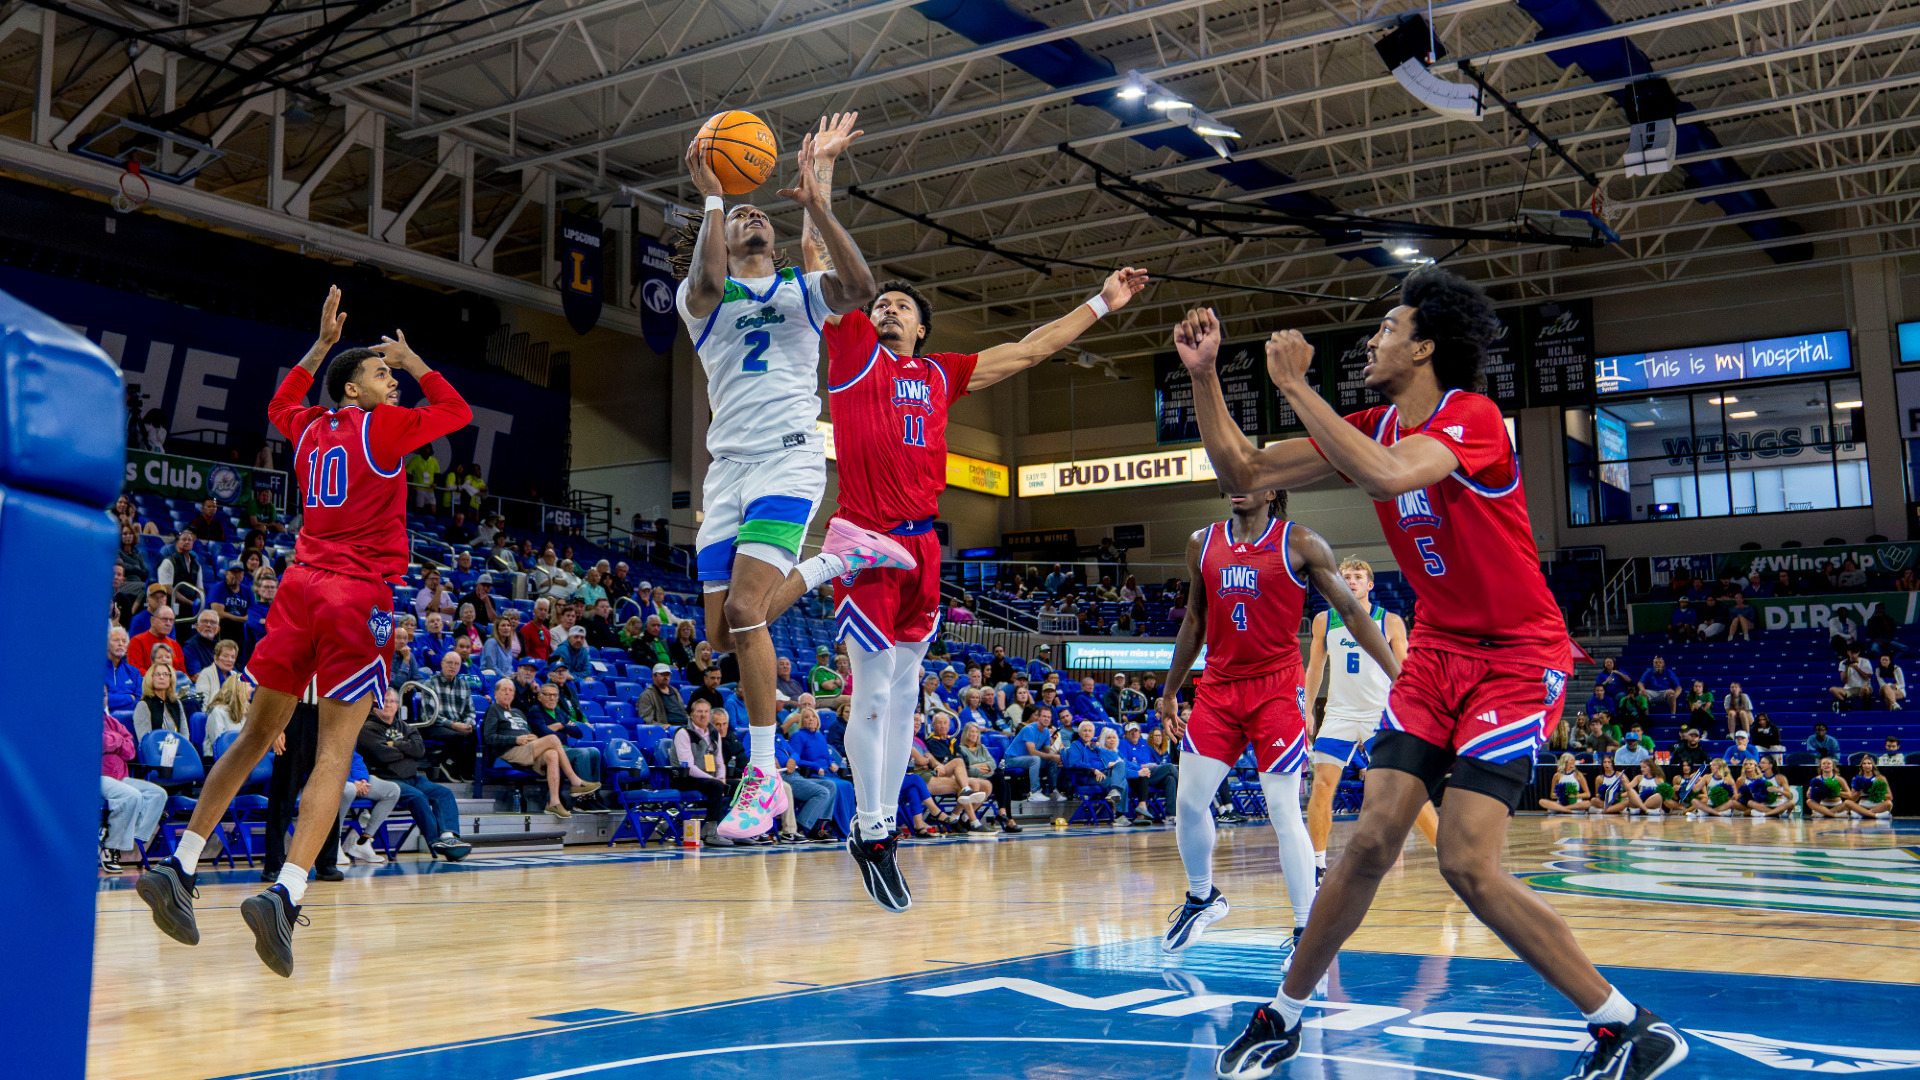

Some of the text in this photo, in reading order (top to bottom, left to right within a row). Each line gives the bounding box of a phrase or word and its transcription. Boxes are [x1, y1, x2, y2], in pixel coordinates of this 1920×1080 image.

[563, 227, 600, 248] LIPSCOMB
[571, 250, 593, 294] L
[735, 308, 786, 330] Eagles
[1538, 319, 1580, 338] FGCU
[741, 330, 771, 372] 2
[1535, 354, 1587, 367] APPEARANCES
[1547, 345, 1574, 357] NCAA
[1635, 336, 1833, 379] This is my hospital.
[1220, 357, 1255, 376] FGCU
[896, 380, 931, 405] UWG
[1225, 391, 1260, 401] URNAMENT
[1227, 382, 1249, 393] NCAA
[903, 414, 926, 446] 11
[1662, 427, 1804, 466] WINGS
[144, 460, 203, 490] Club
[306, 445, 349, 507] 10
[1059, 456, 1188, 487] BUD LIGHT
[1396, 487, 1432, 518] UWG
[555, 510, 571, 526] GG
[1044, 533, 1069, 543] WINE
[1413, 536, 1446, 577] 5
[1221, 566, 1257, 591] UWG
[1231, 602, 1248, 631] 4
[1078, 648, 1105, 658] Eagles
[1130, 648, 1149, 657] miss
[1346, 652, 1360, 674] 6
